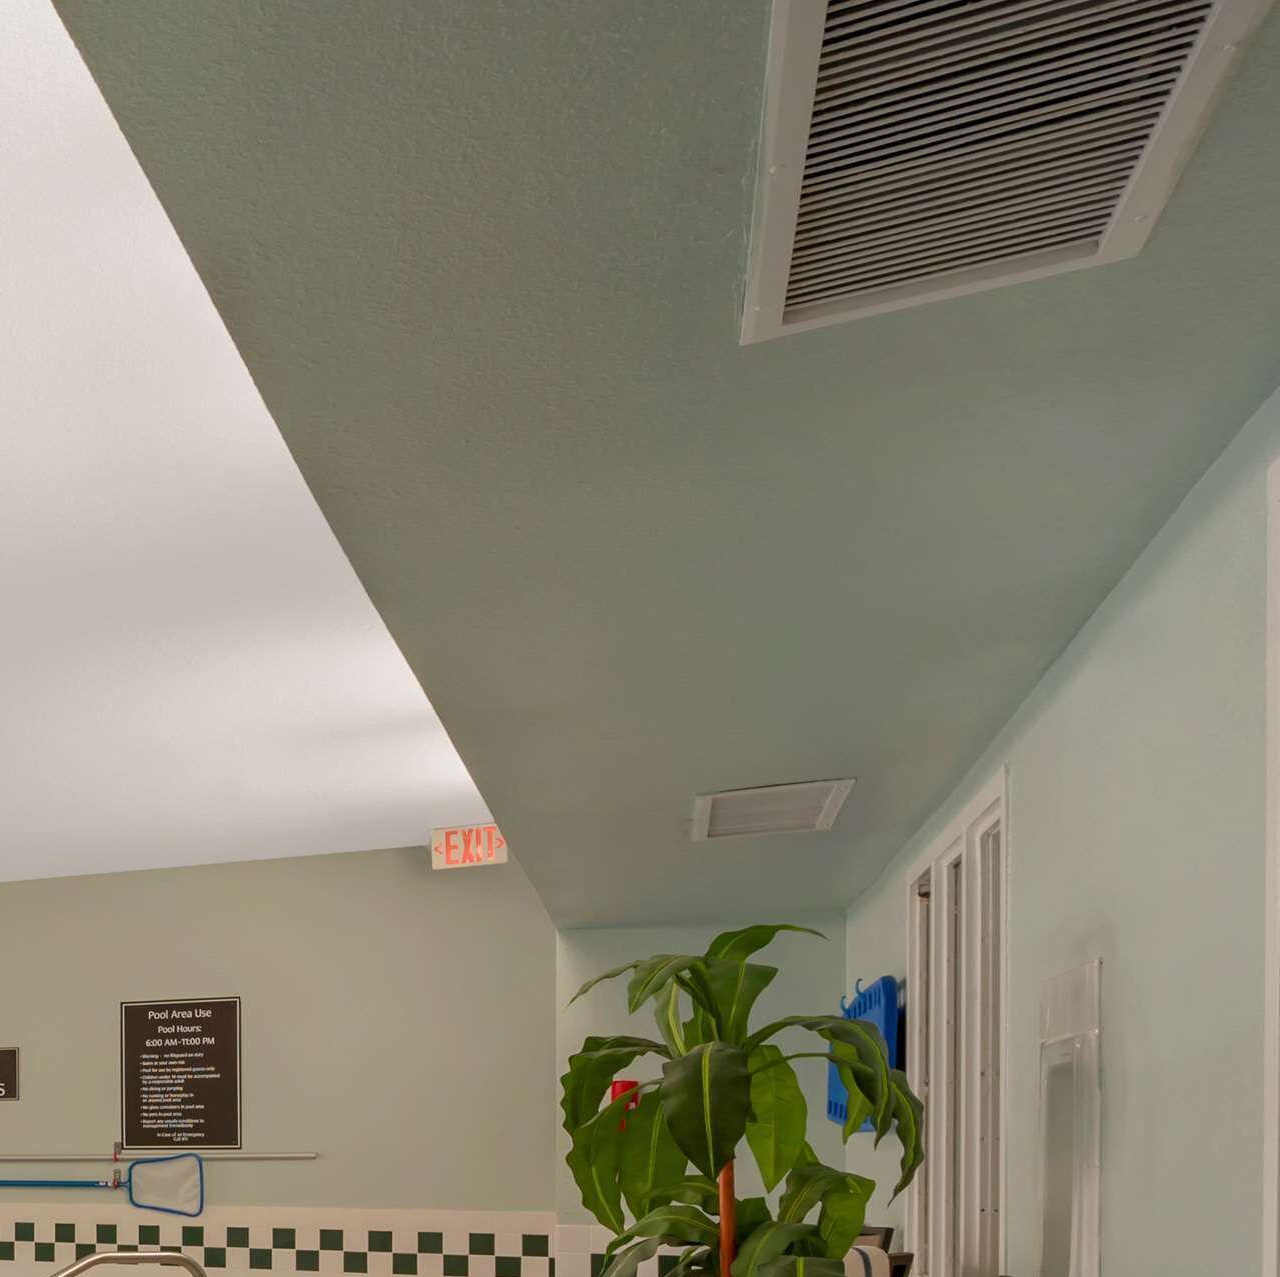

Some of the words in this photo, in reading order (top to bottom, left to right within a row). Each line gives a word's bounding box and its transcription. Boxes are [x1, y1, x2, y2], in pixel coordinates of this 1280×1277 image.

[445, 826, 497, 864] EXIT
[148, 1010, 169, 1020] Pool
[171, 1010, 192, 1019] Area
[194, 1008, 212, 1018] Use
[158, 1025, 175, 1033] Pool
[176, 1024, 201, 1032] Hours:
[145, 1038, 163, 1047] 6:00
[202, 1037, 215, 1045] PM
